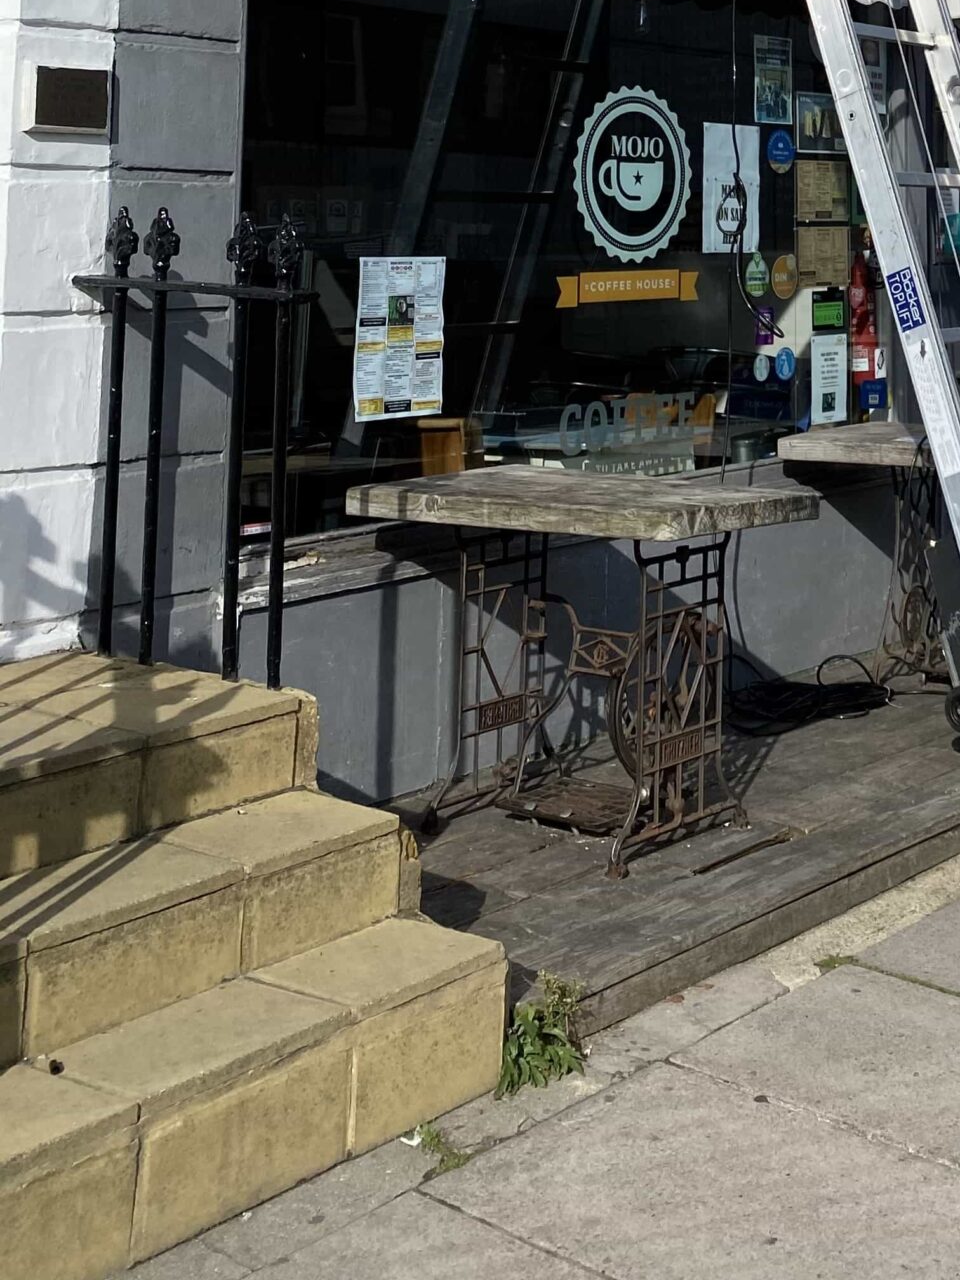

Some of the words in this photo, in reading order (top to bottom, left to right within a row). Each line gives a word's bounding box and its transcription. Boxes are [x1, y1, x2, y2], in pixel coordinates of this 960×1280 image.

[610, 134, 664, 158] MOJO
[590, 280, 632, 293] COFFEE
[636, 278, 671, 290] HOUSE
[888, 273, 913, 328] TOPLIFT
[900, 268, 923, 324] Böcker
[559, 391, 696, 456] COFFEE
[612, 461, 636, 473] TAKE
